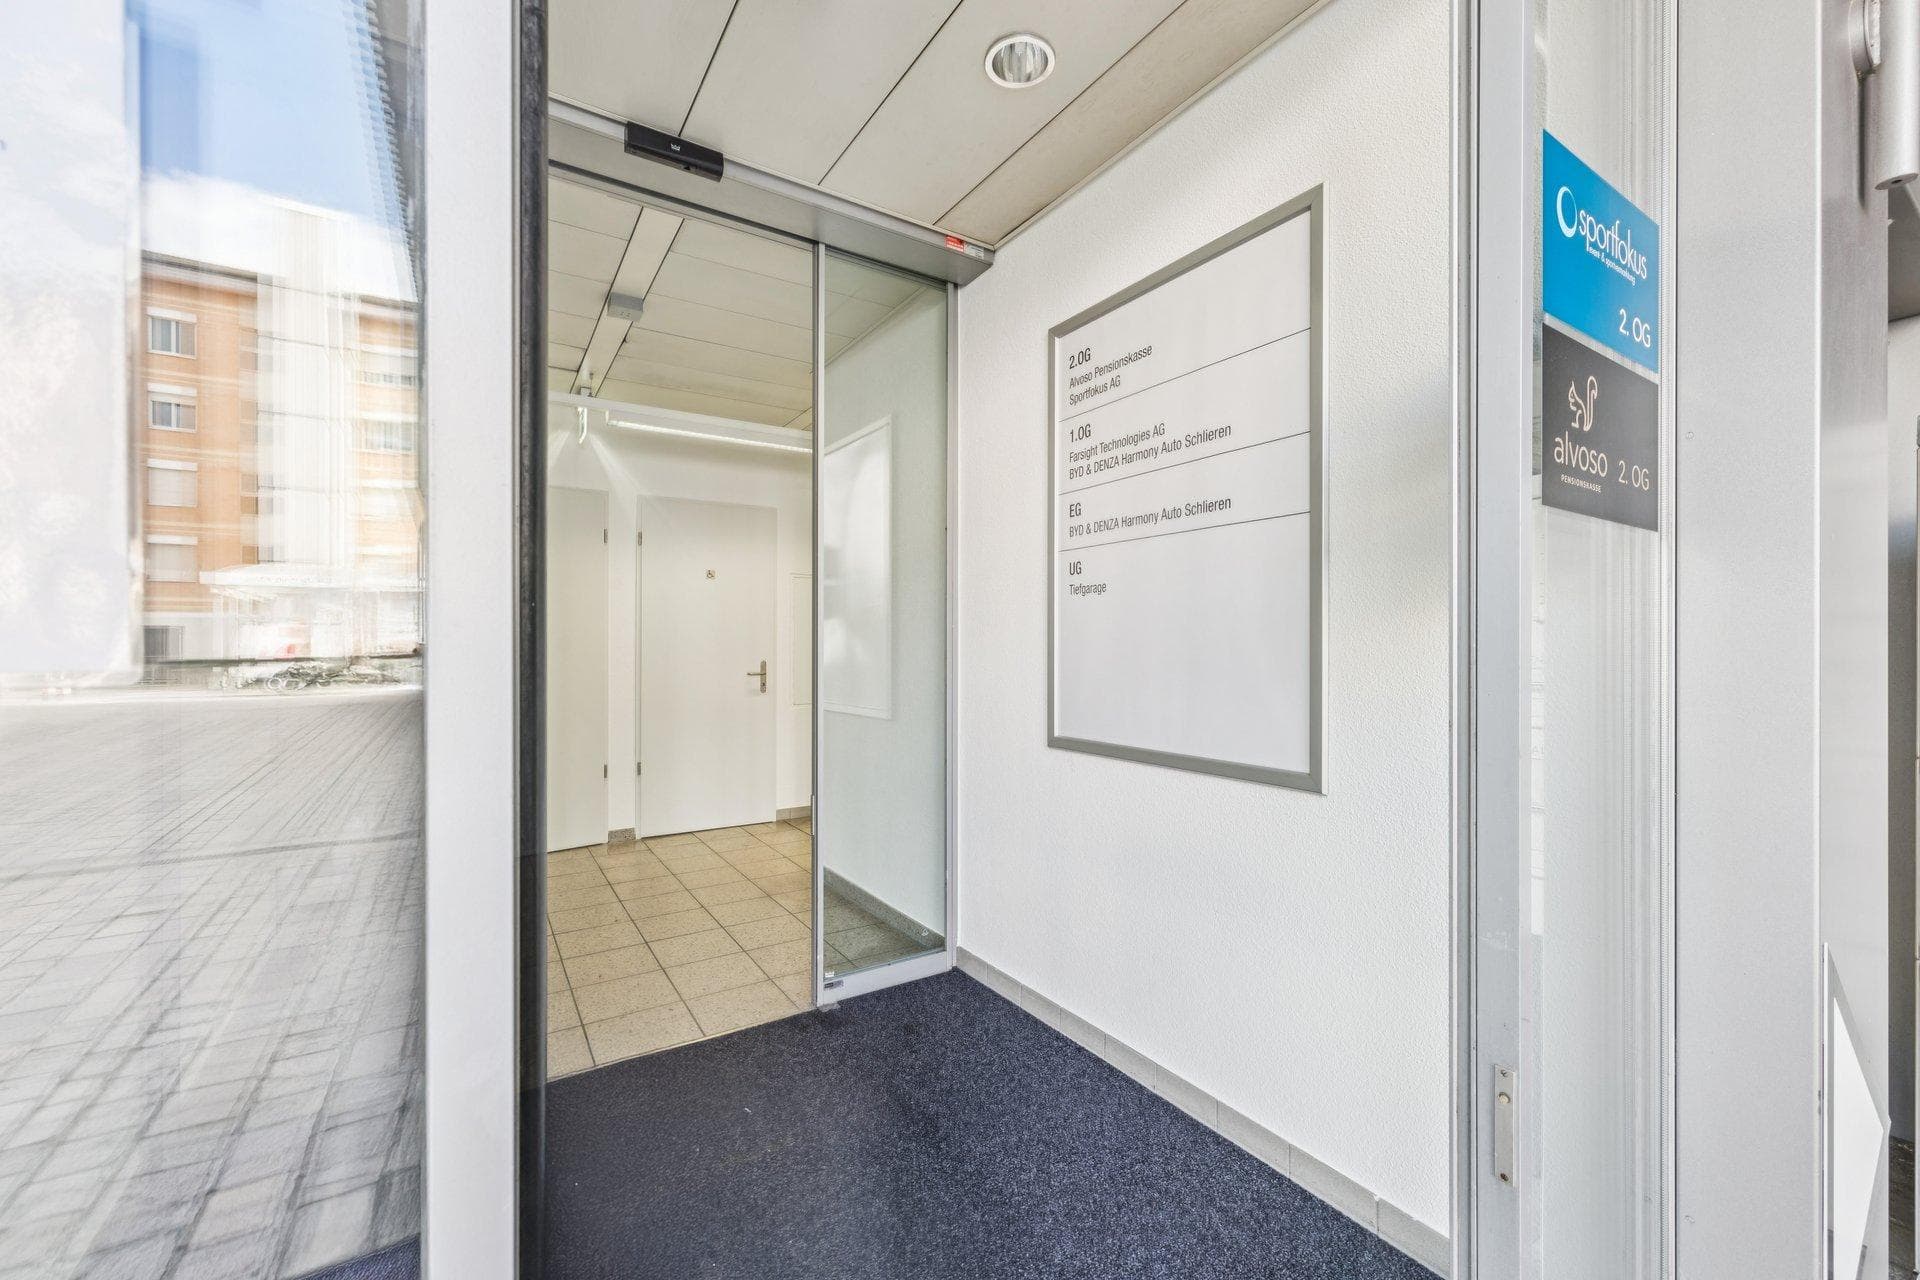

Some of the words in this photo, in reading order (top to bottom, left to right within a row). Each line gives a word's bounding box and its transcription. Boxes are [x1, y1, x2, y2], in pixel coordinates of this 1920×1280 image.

[1579, 209, 1647, 280] sportfokus
[1619, 308, 1630, 336] 2.
[1633, 317, 1651, 348] OG
[1069, 347, 1091, 370] 2.OG
[1069, 371, 1093, 389] Alvoso
[1094, 345, 1153, 378] Pensionskasse
[1069, 382, 1108, 406] Sportfokus
[1109, 374, 1121, 390] AG
[1069, 423, 1091, 443] 1.OG
[1069, 444, 1098, 463] Farsight
[1099, 430, 1151, 454] Technologies
[1152, 423, 1166, 439] AG
[1069, 465, 1084, 480] BYD
[1085, 463, 1092, 476] &
[1093, 455, 1119, 473] DENZA
[1121, 446, 1159, 466] Harmony
[1160, 438, 1182, 455] Auto
[1184, 425, 1232, 448] Schlieren
[1554, 430, 1608, 478] alvoso
[1560, 474, 1602, 493] PENSIONSKASSE
[1618, 460, 1628, 485] 2.
[1632, 465, 1650, 491] OG
[1069, 502, 1082, 518] EG
[1069, 524, 1084, 538] BYD
[1085, 523, 1092, 535] &
[1093, 517, 1119, 534] DENZA
[1121, 511, 1159, 528] Harmony
[1160, 507, 1182, 521] Auto
[1184, 497, 1232, 517] Schlieren
[1069, 561, 1082, 576] UG
[1069, 582, 1107, 597] Tiefgarage
